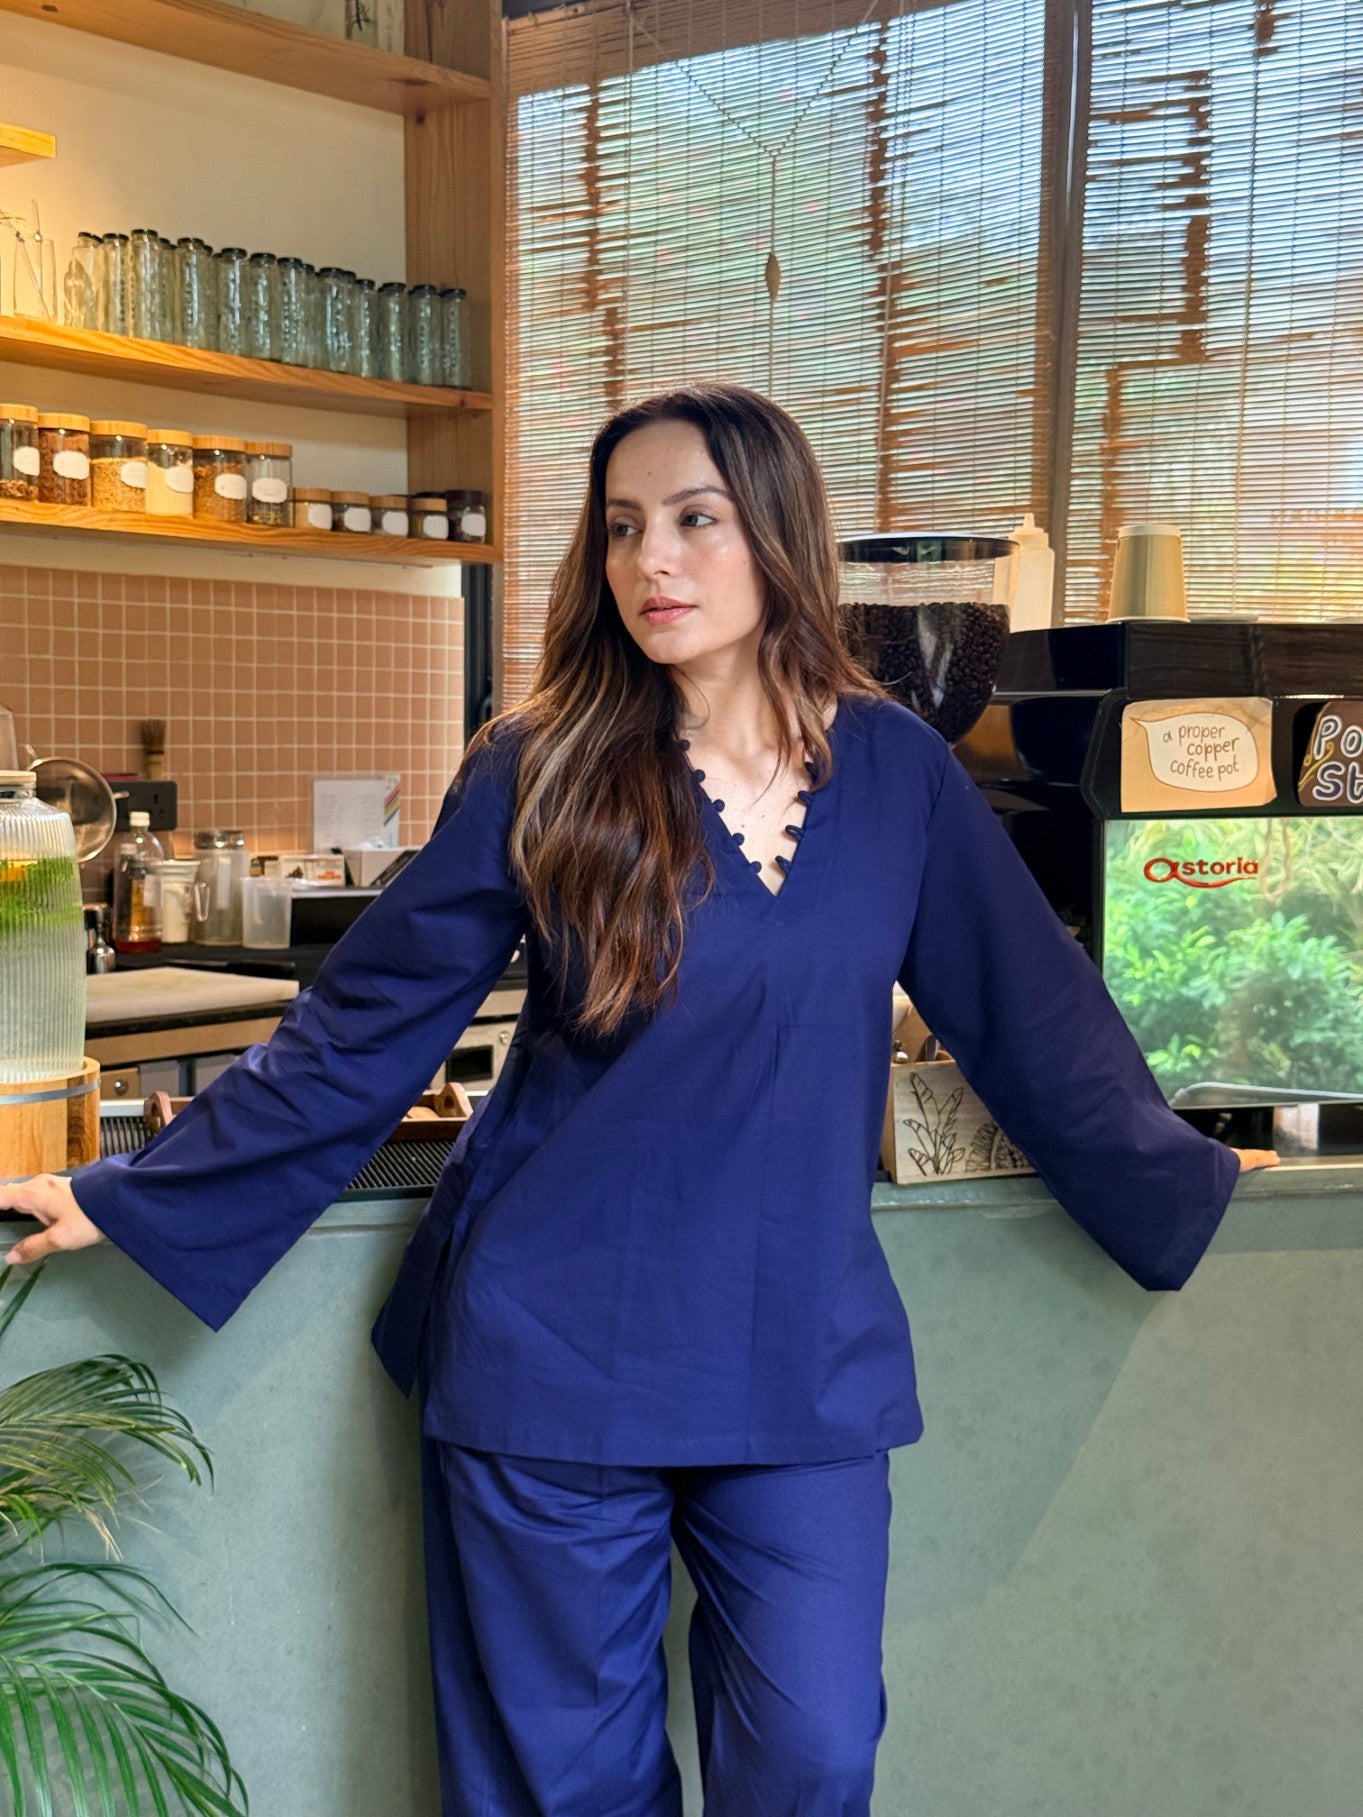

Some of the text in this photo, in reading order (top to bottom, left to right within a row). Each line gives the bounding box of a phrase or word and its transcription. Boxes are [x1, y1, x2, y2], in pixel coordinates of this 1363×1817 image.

[1162, 725, 1226, 746] a proper
[1187, 737, 1239, 762] copper
[1170, 754, 1239, 781] coffee pot
